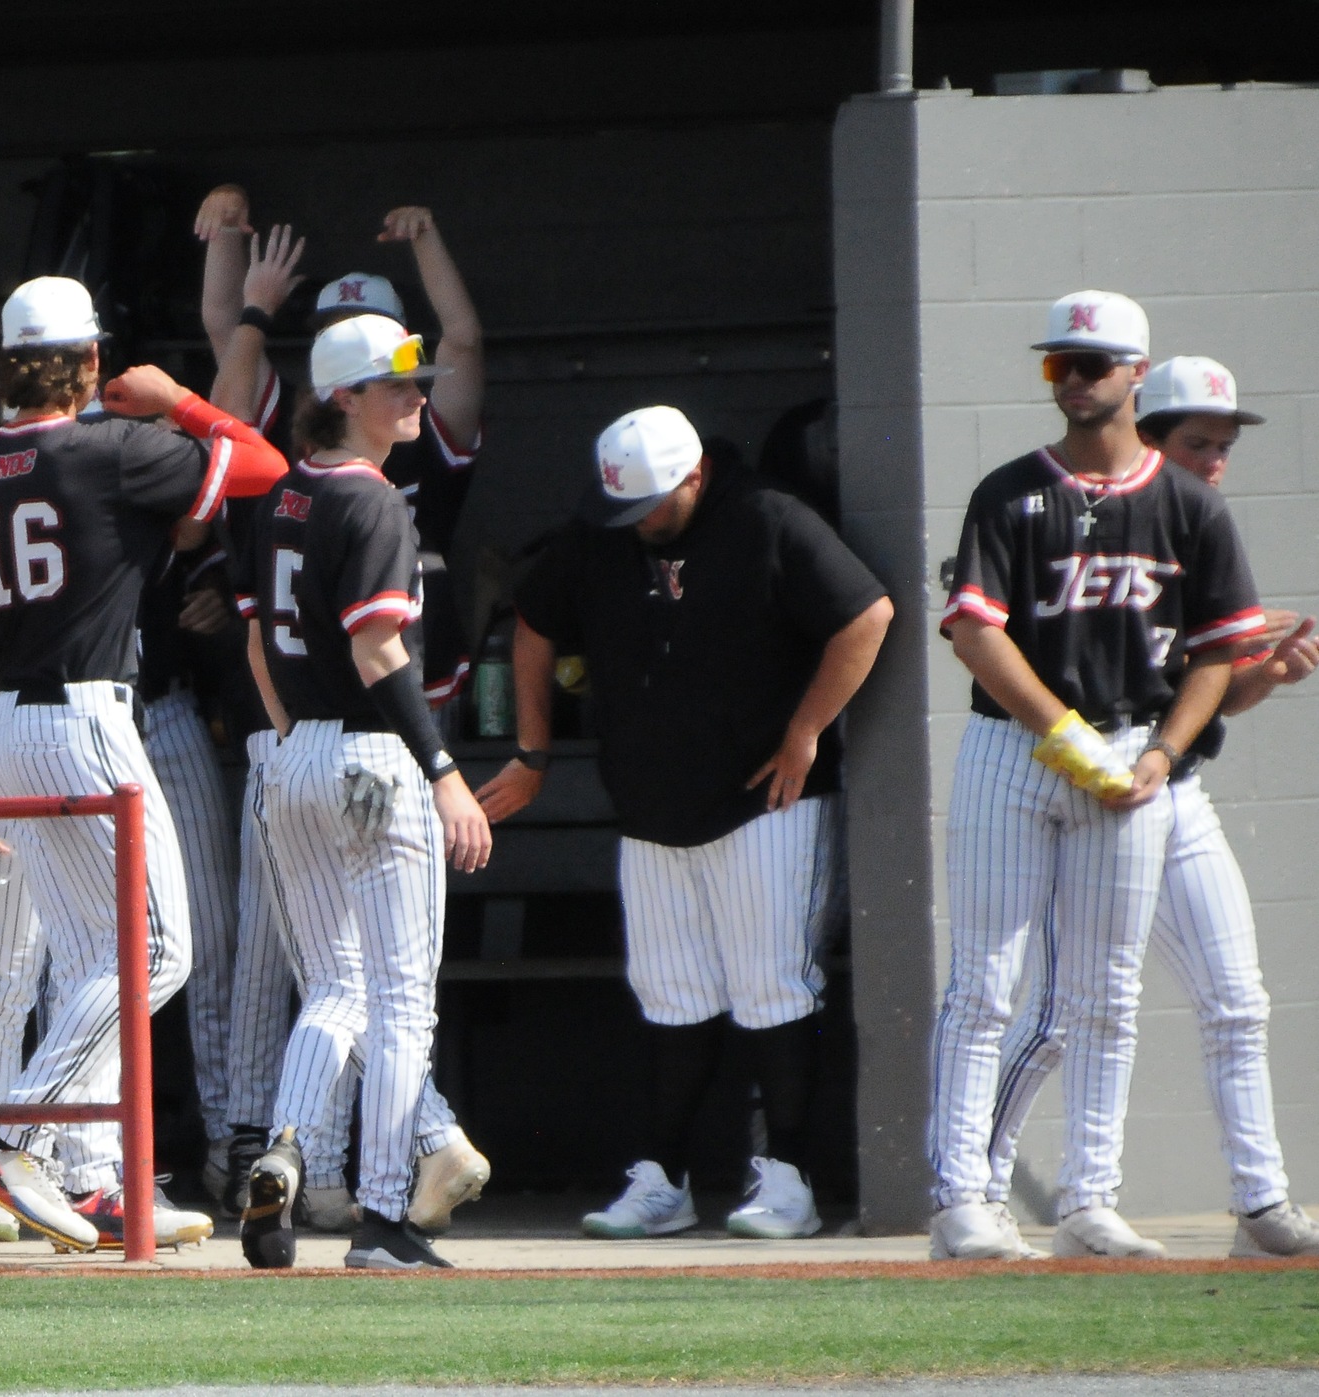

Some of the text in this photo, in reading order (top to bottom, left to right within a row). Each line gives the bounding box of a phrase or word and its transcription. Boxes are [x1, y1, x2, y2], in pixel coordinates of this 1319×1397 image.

[1067, 303, 1100, 332] N
[1204, 371, 1232, 402] N
[273, 547, 309, 657] 5
[1033, 552, 1183, 618] JETS
[1151, 625, 1178, 668] 7
